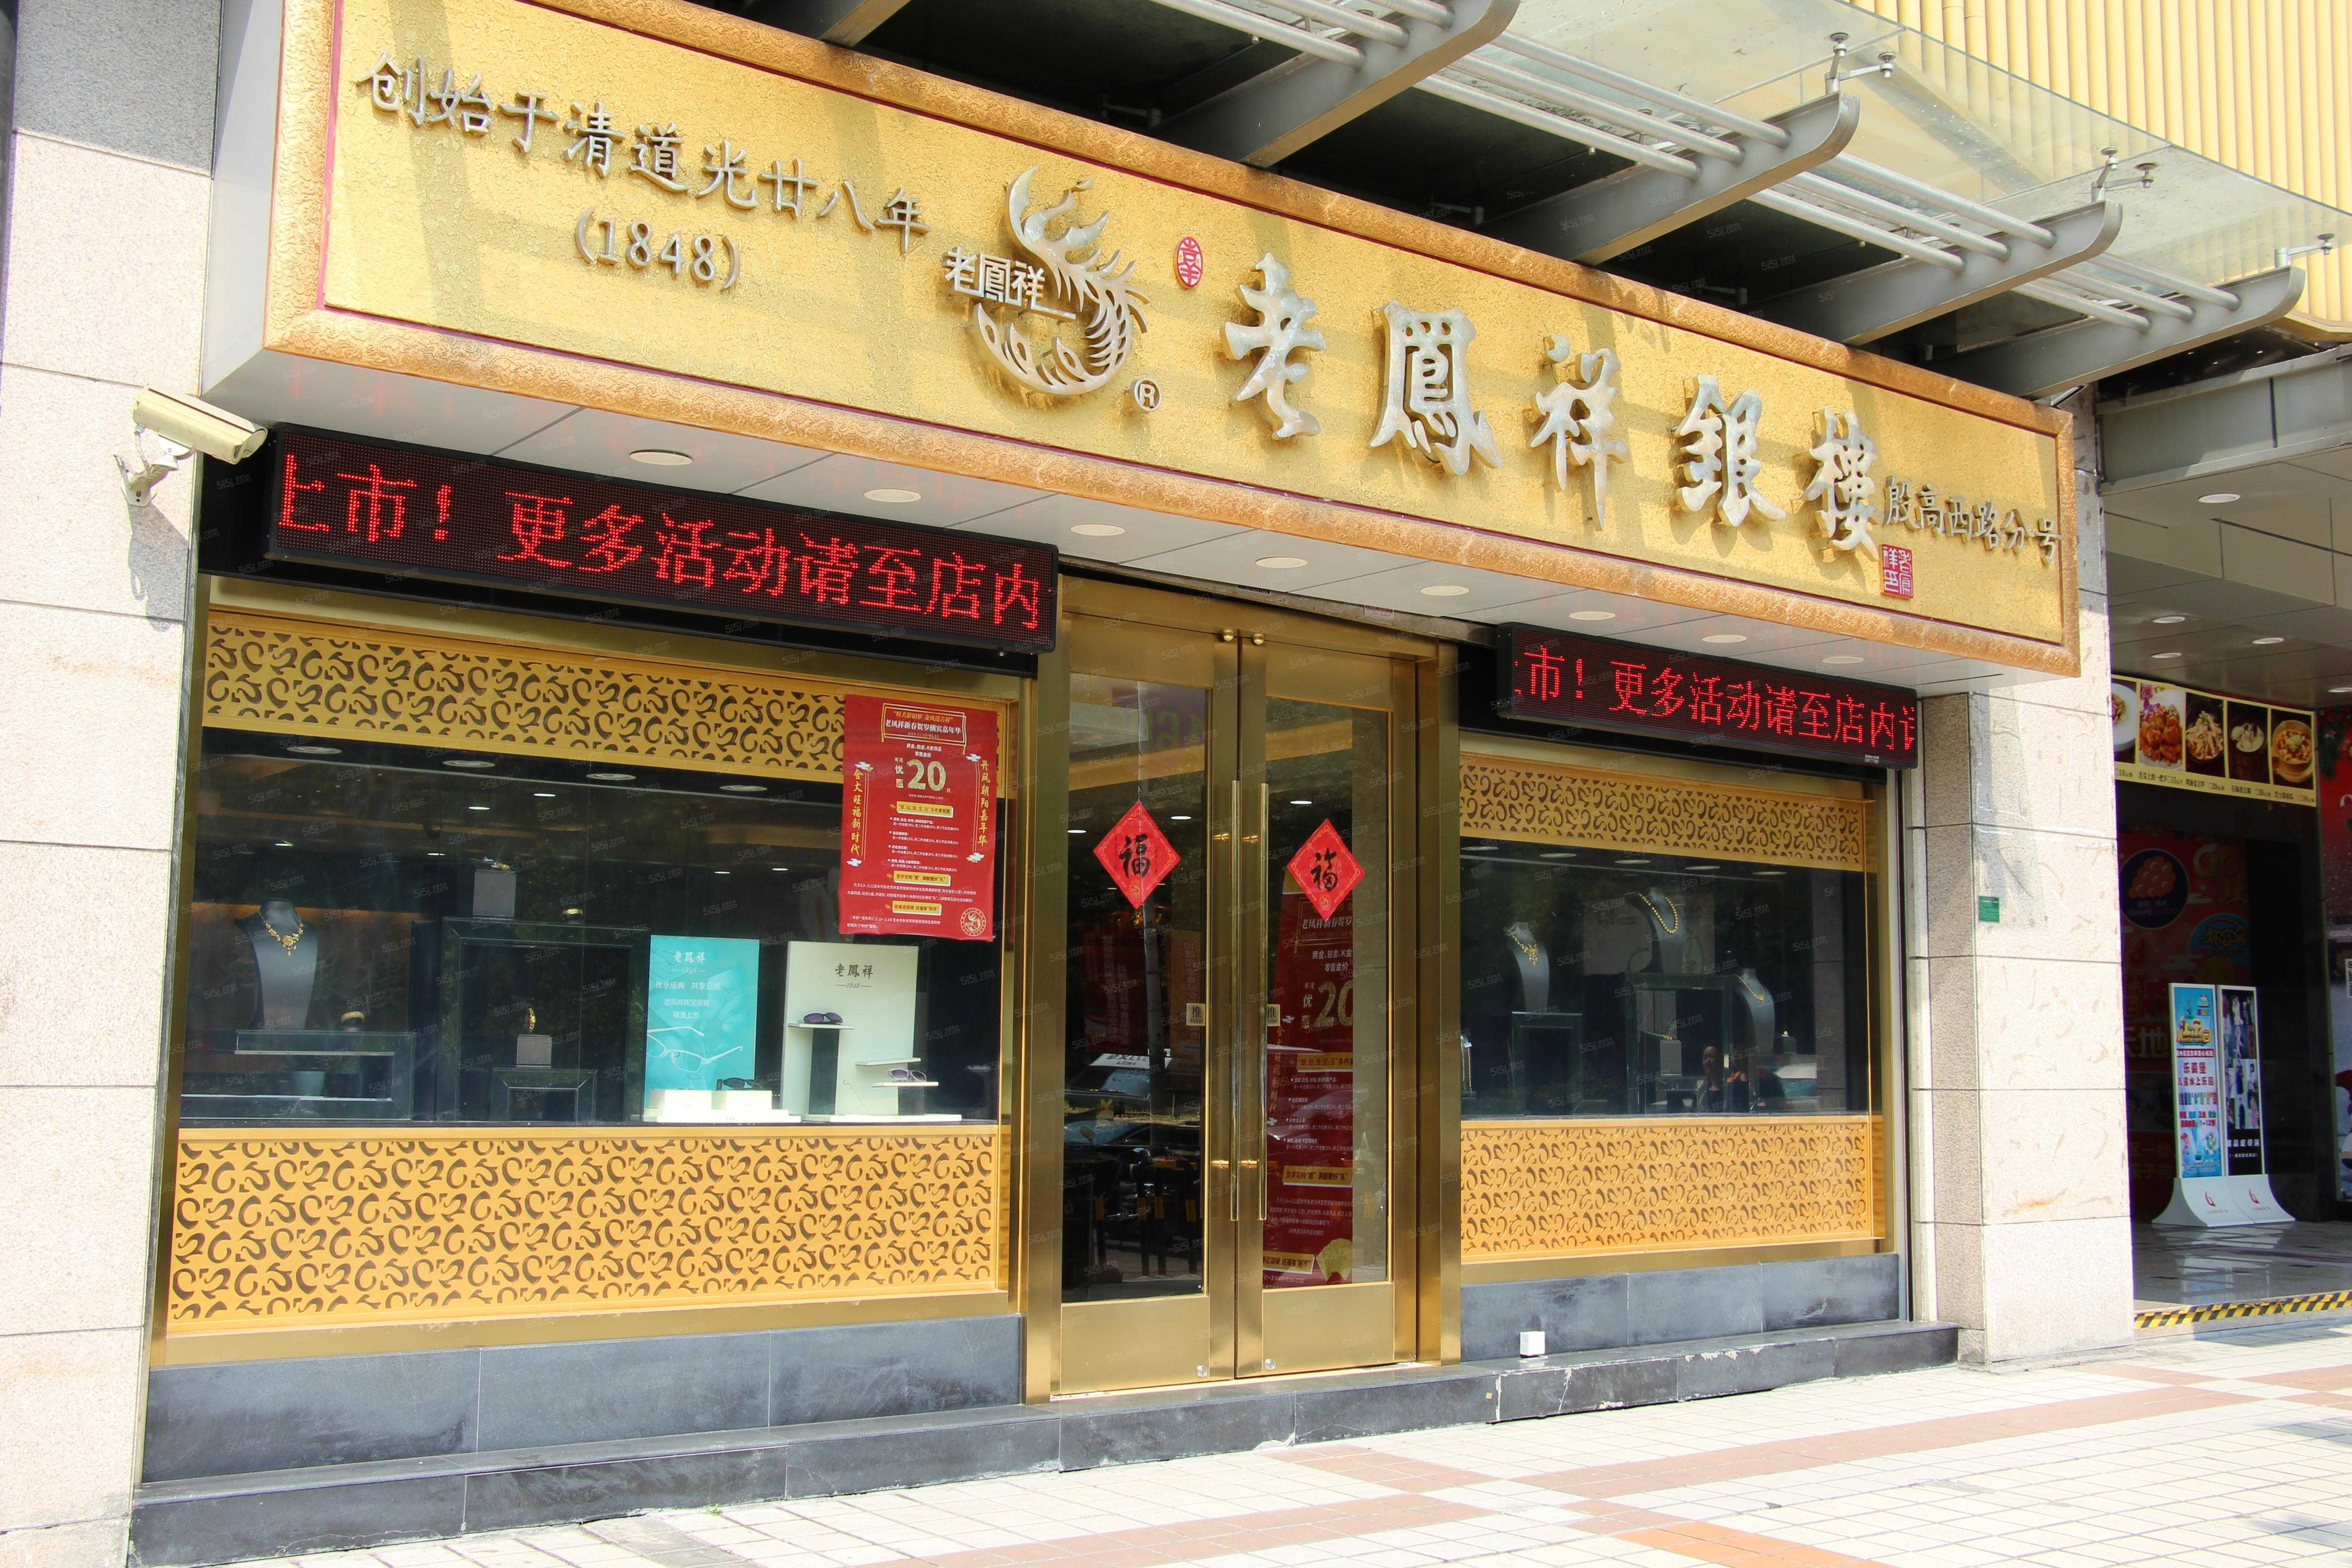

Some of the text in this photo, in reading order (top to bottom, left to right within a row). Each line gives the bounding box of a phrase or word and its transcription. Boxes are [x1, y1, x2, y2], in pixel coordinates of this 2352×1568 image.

[356, 50, 931, 254] 创始于清道光廿八年
[1882, 475, 2062, 565] 殷高西路分号
[907, 759, 946, 791] 20
[850, 768, 864, 857] 金犬旺福新时代
[1119, 833, 1152, 879] 福
[1191, 1005, 1202, 1018] 推
